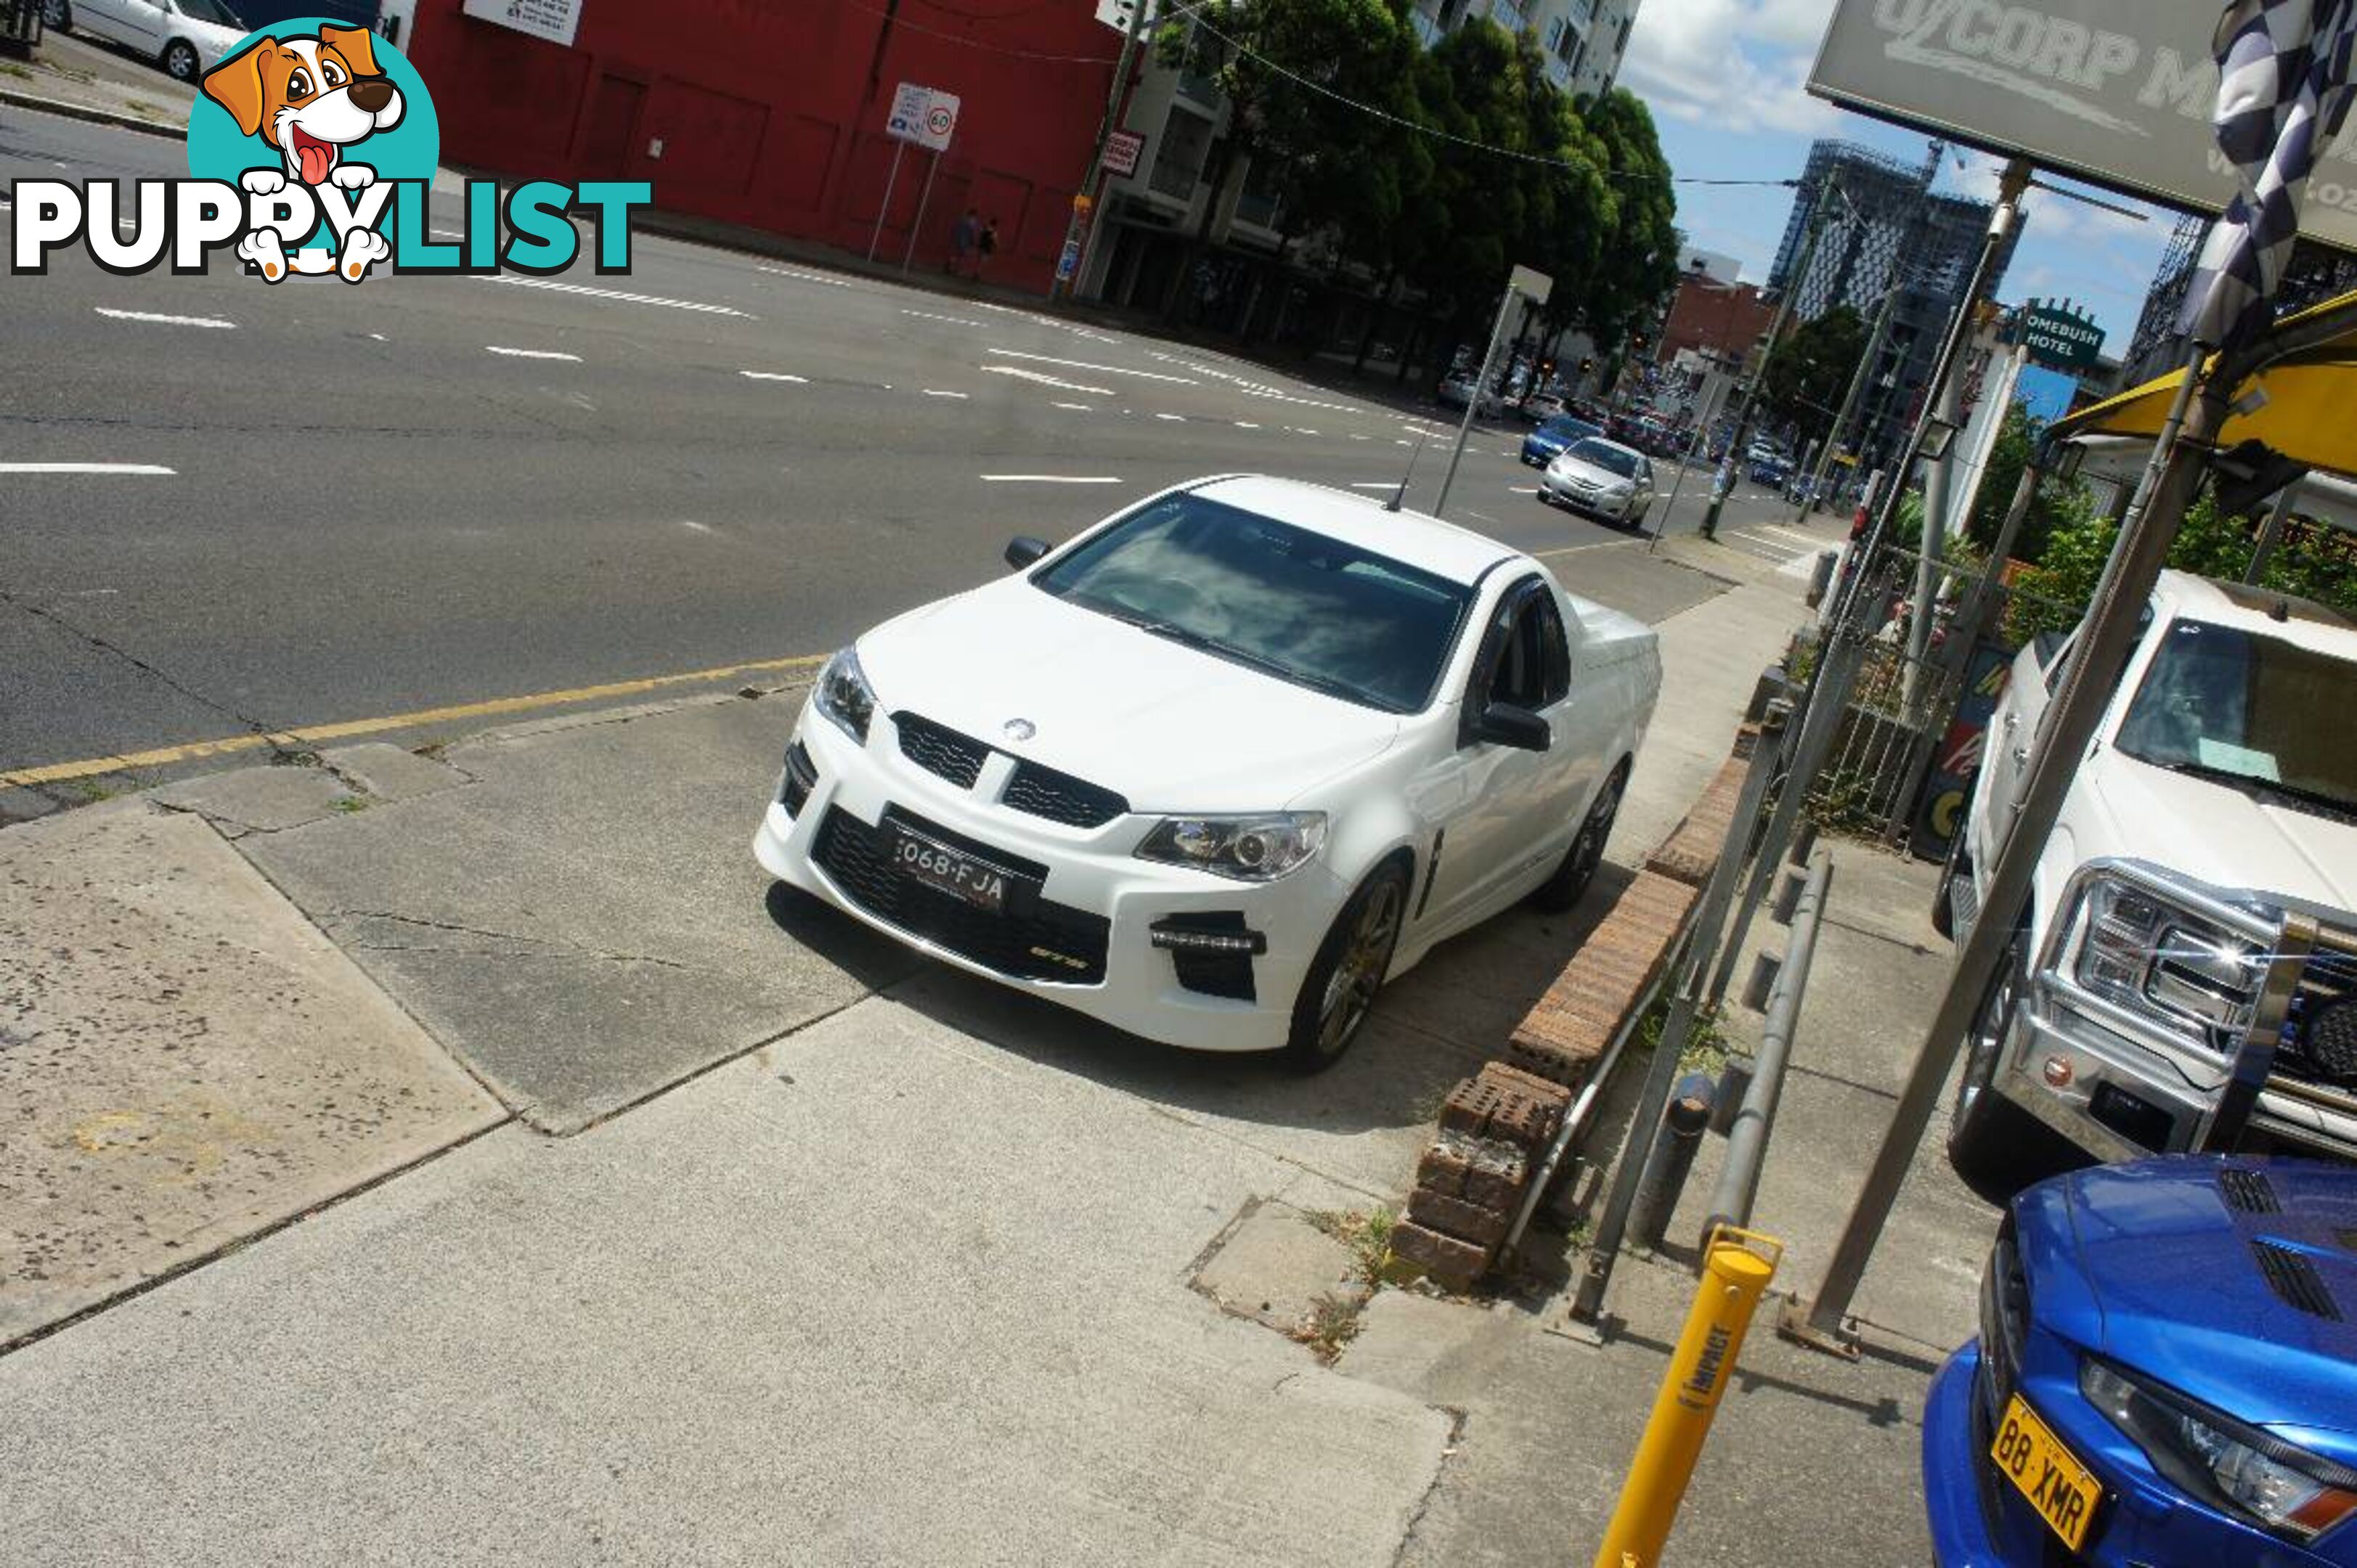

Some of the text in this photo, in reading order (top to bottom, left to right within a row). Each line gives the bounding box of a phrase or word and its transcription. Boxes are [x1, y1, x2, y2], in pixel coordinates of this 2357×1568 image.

[931, 115, 948, 127] 60
[2026, 314, 2099, 346] OMEBUSH
[2027, 332, 2075, 356] HOTEL
[1682, 1323, 1731, 1395] IMPACT
